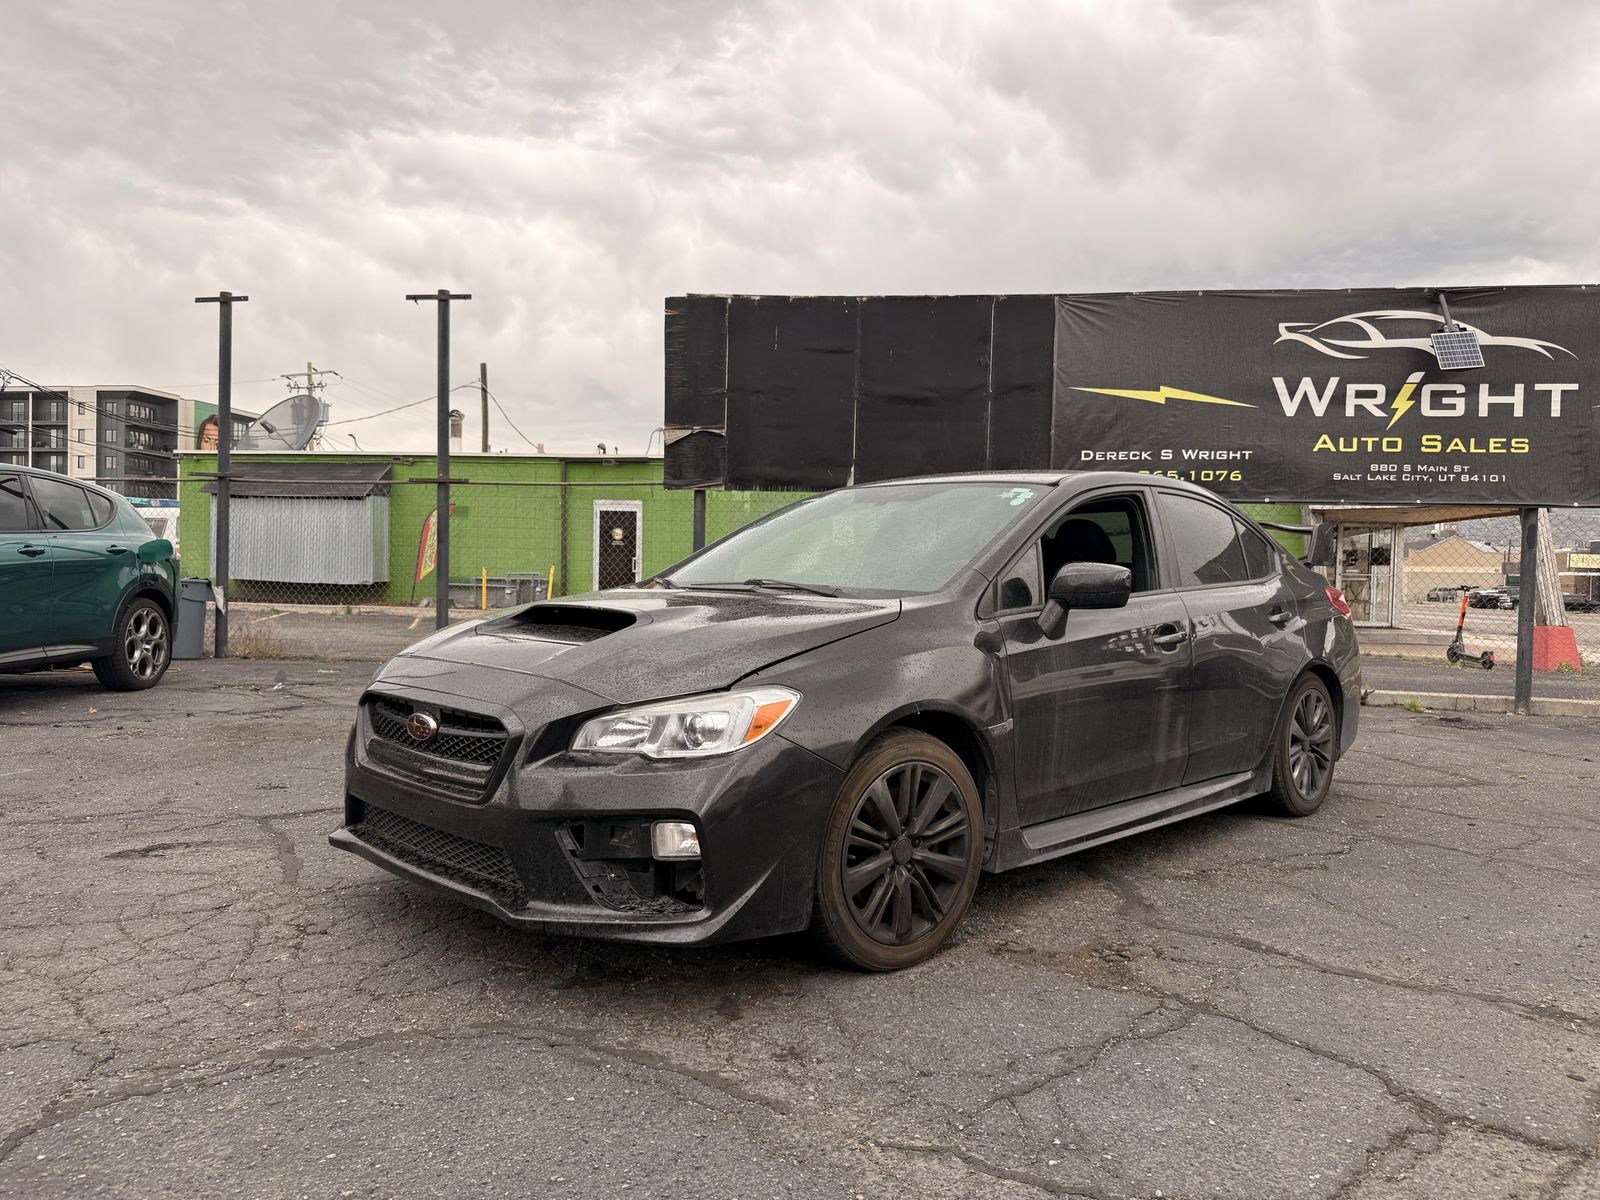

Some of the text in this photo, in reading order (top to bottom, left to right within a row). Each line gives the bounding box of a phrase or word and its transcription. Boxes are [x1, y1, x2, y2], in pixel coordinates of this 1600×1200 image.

[1271, 371, 1580, 431] WRIGHT
[1312, 433, 1530, 453] AUTO SALES
[1080, 448, 1253, 461] DERECK S WRIGHT
[1370, 463, 1470, 473] 880 S MAIN ST
[1332, 472, 1506, 483] SALT LAKE CITY, UT 84101
